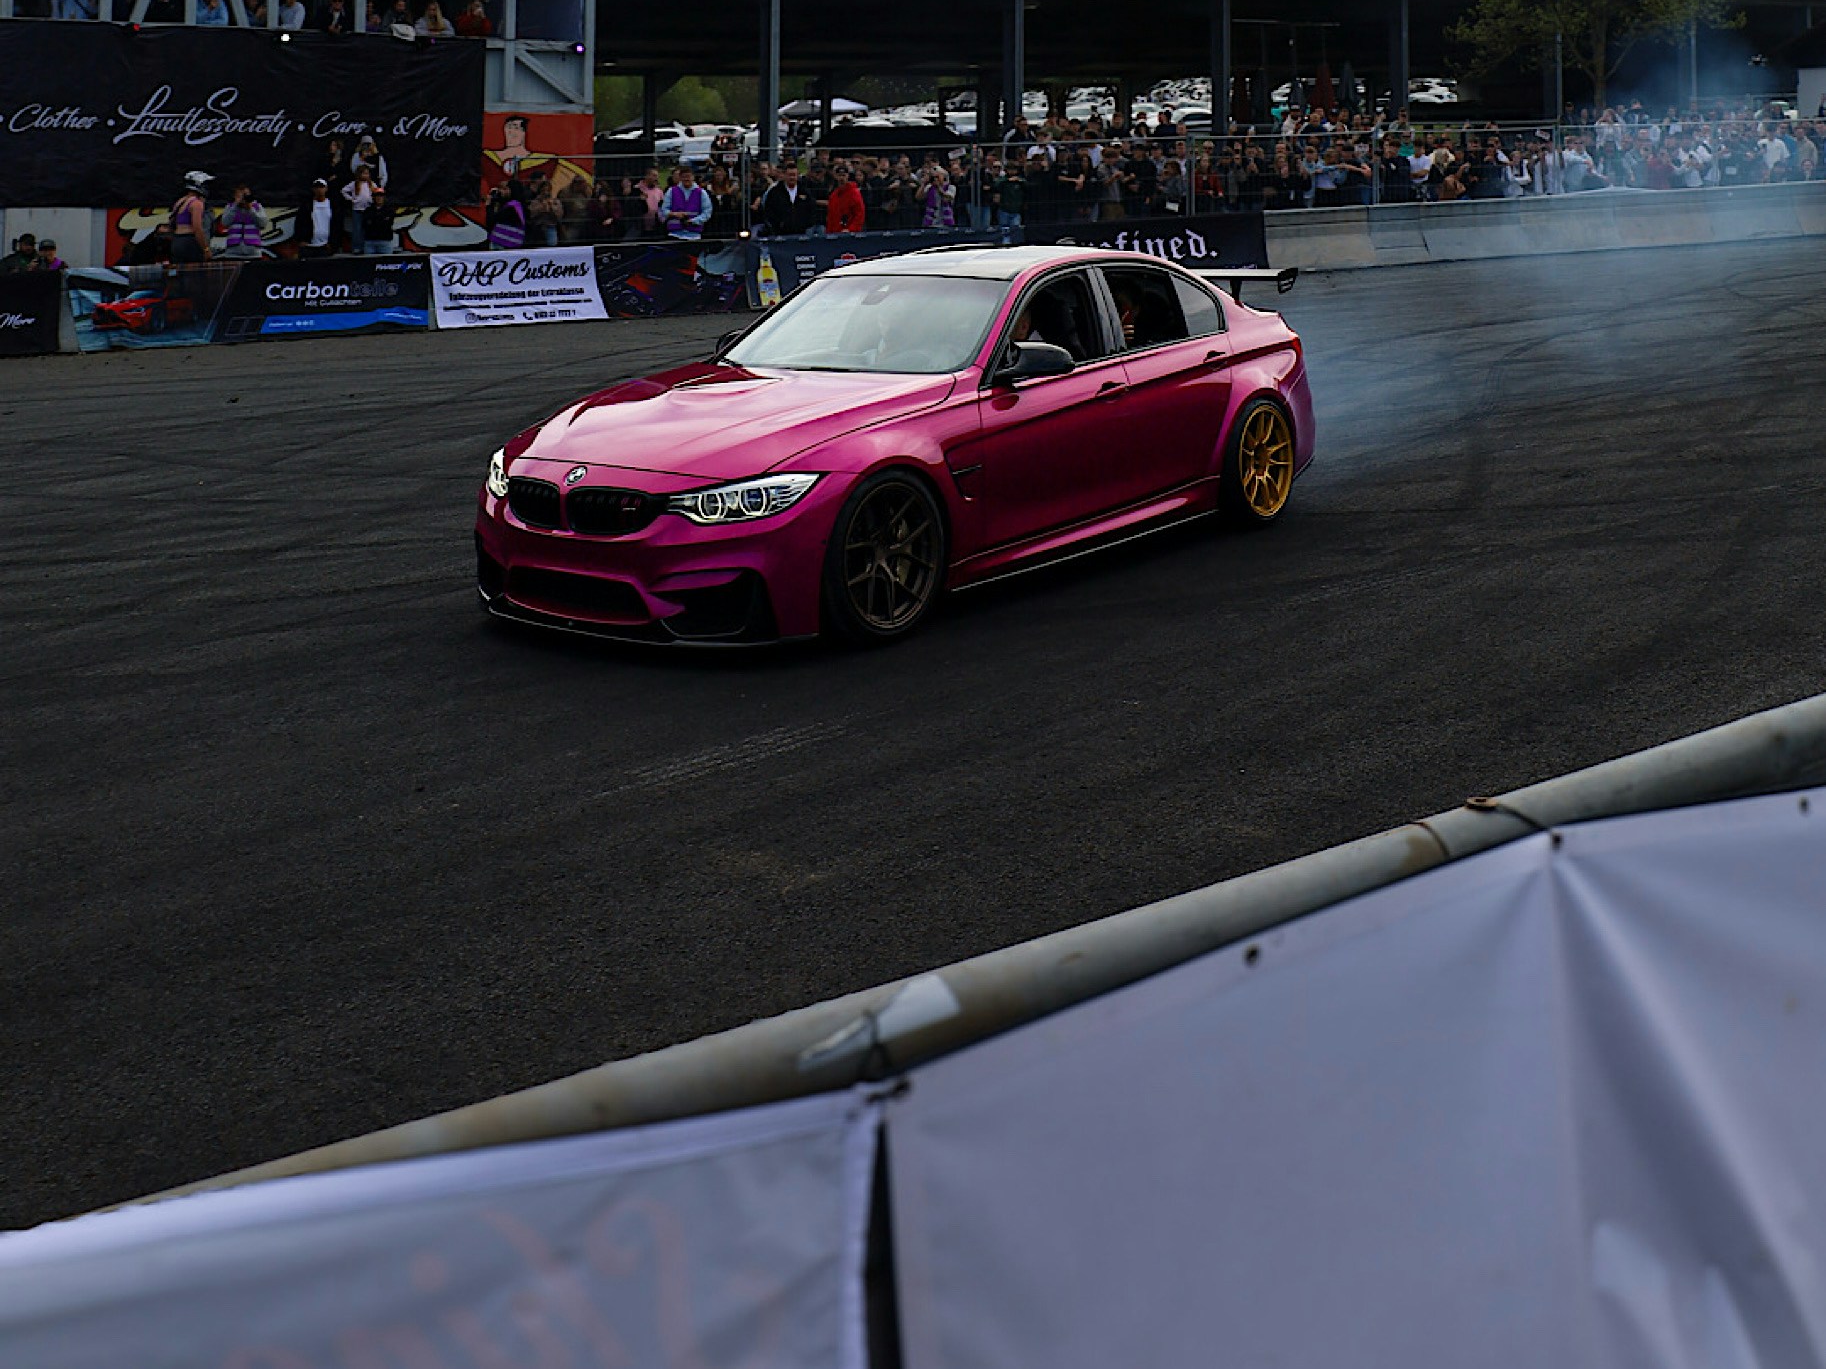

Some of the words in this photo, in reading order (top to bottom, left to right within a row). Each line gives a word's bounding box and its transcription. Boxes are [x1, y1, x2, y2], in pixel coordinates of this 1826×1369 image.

[8, 103, 99, 133] Clothes
[312, 111, 369, 137] Cars
[509, 258, 589, 284] Customs
